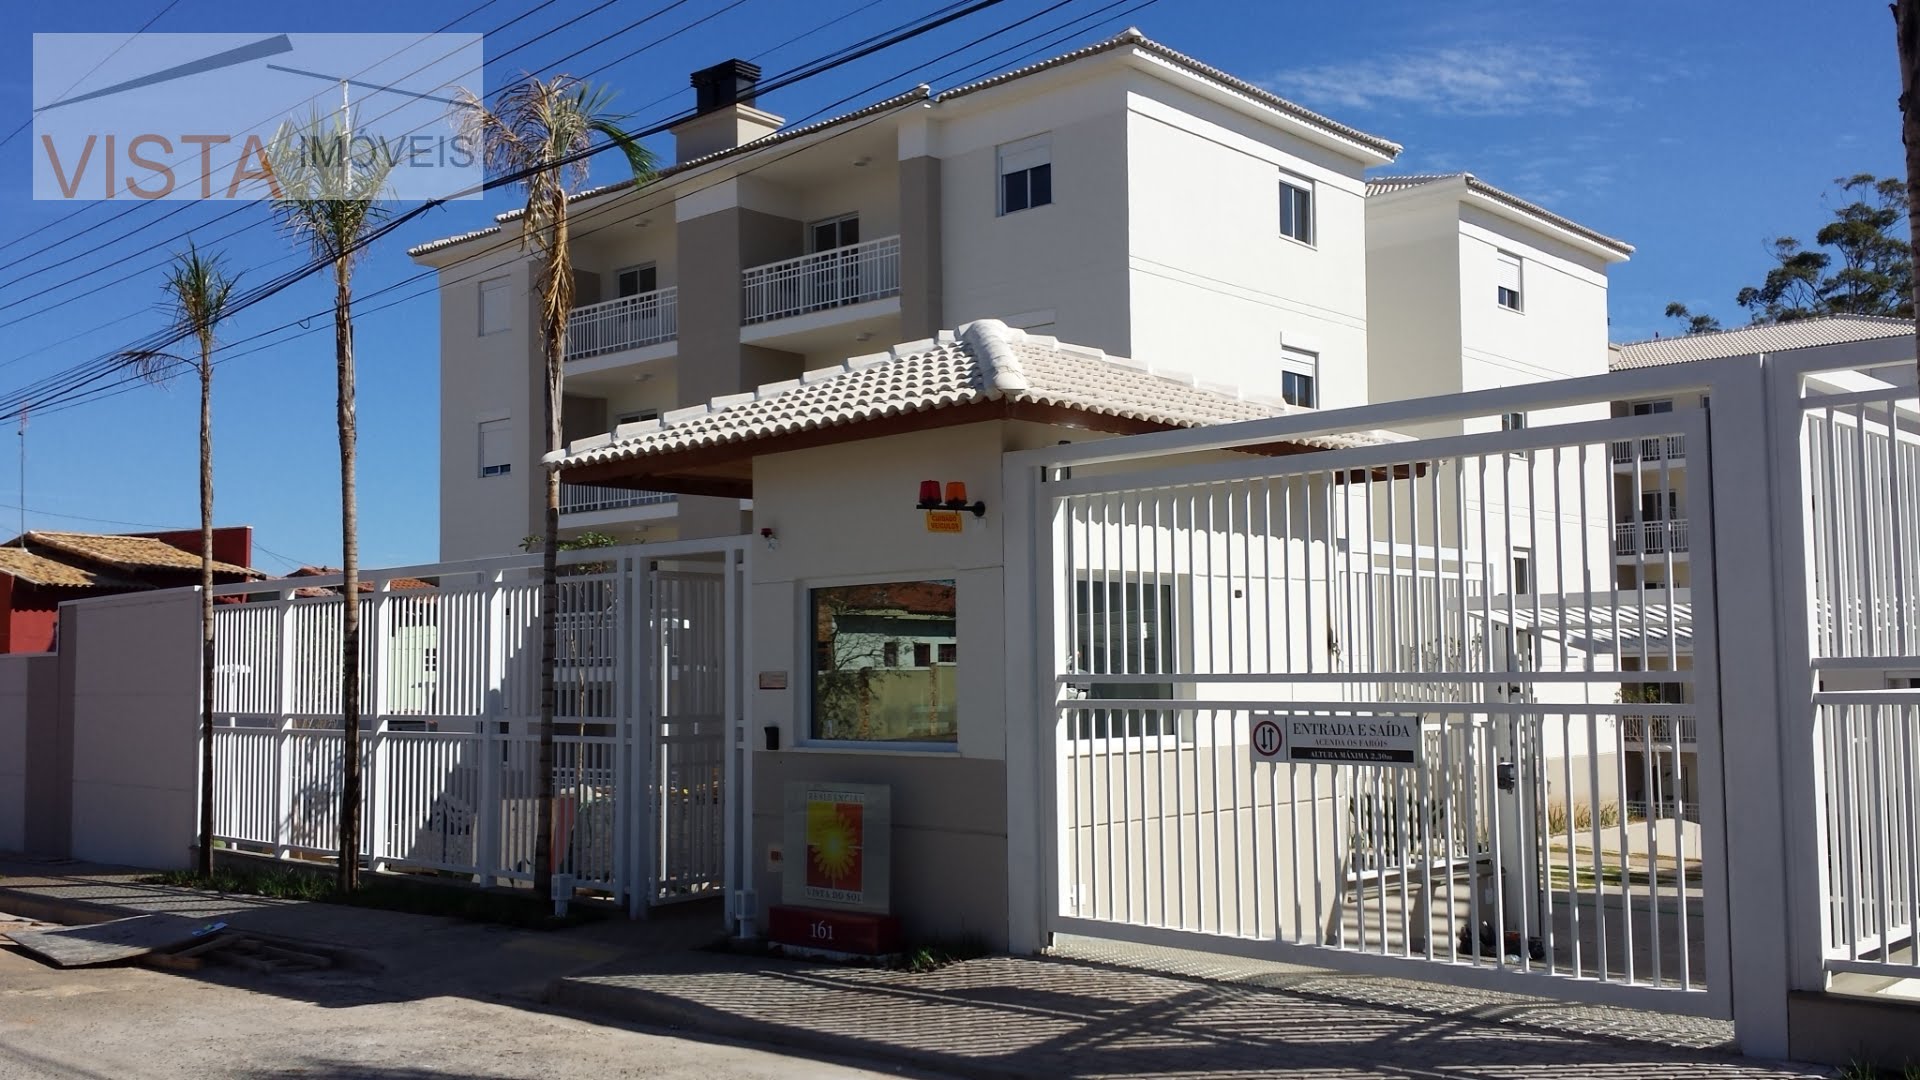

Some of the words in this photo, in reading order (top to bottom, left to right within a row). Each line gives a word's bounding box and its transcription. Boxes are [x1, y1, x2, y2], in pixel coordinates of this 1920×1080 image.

[1293, 723, 1355, 736] ENTRADA
[1357, 724, 1367, 737] E
[1369, 721, 1411, 738] SAÍDA
[1315, 739, 1345, 747] ACENDA
[1360, 739, 1388, 748] FARÓIS
[1311, 751, 1338, 759] ALTURA
[1340, 751, 1369, 760] MÁXIMA
[806, 888, 830, 898] VISTA
[832, 891, 844, 900] DO
[846, 892, 861, 902] SOL
[809, 920, 833, 940] 161
